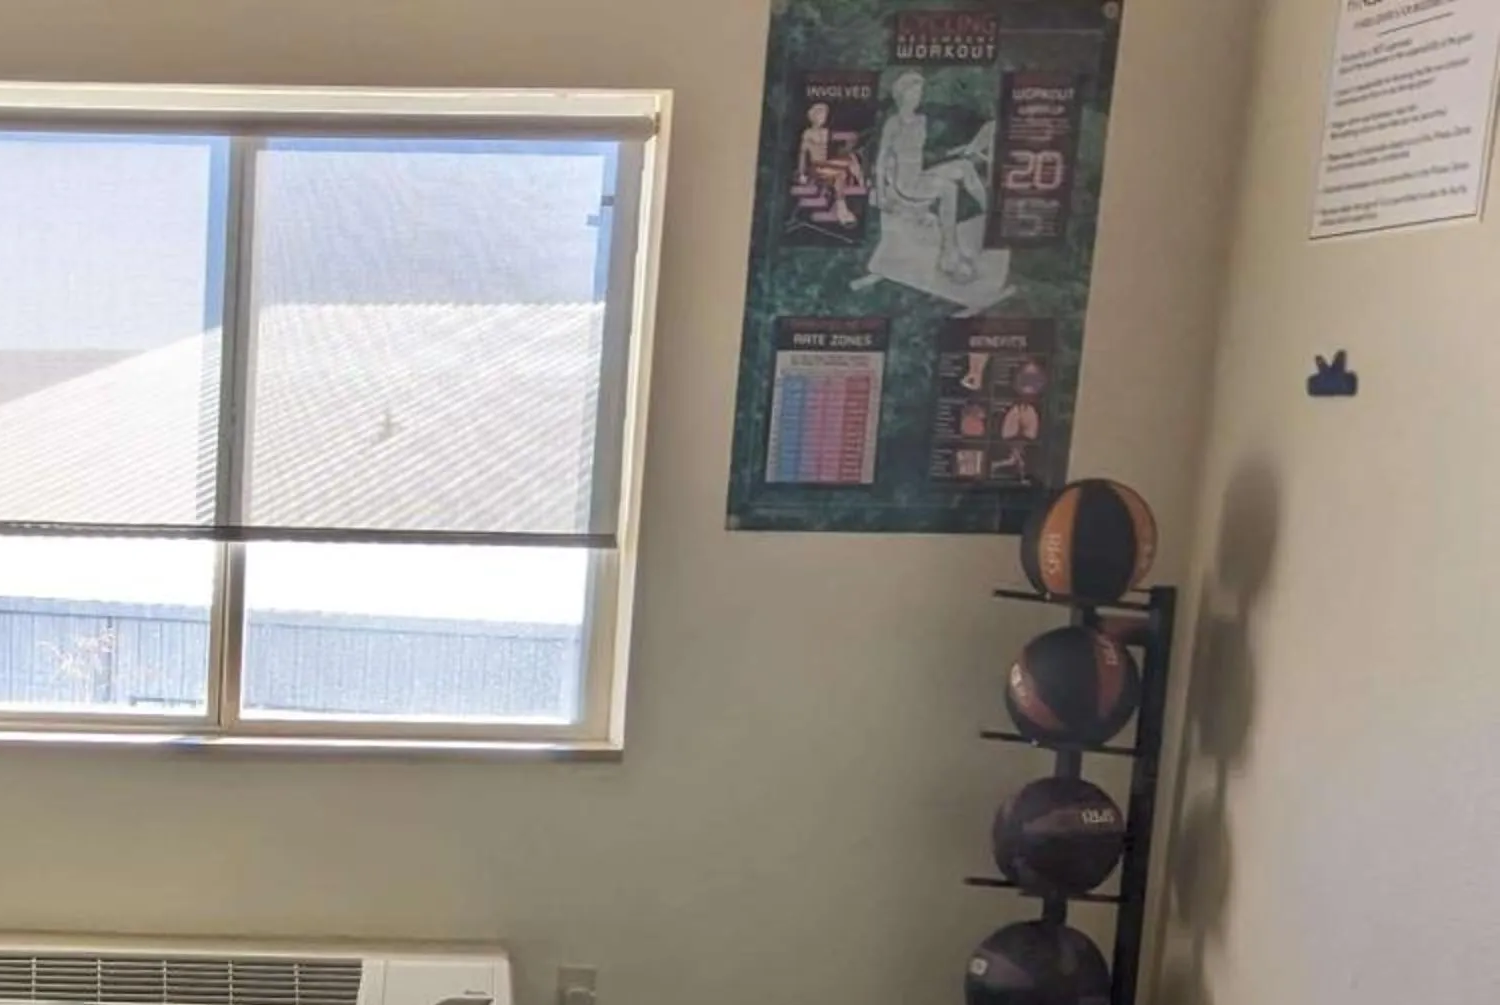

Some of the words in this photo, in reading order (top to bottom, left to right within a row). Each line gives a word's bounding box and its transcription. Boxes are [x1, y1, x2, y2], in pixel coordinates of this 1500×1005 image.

[896, 44, 996, 59] WORKOUT
[806, 86, 871, 99] INVOLVED
[1005, 150, 1064, 190] 20
[793, 334, 827, 347] RATE
[831, 334, 873, 347] ZONES
[968, 335, 1027, 349] BENEFITS
